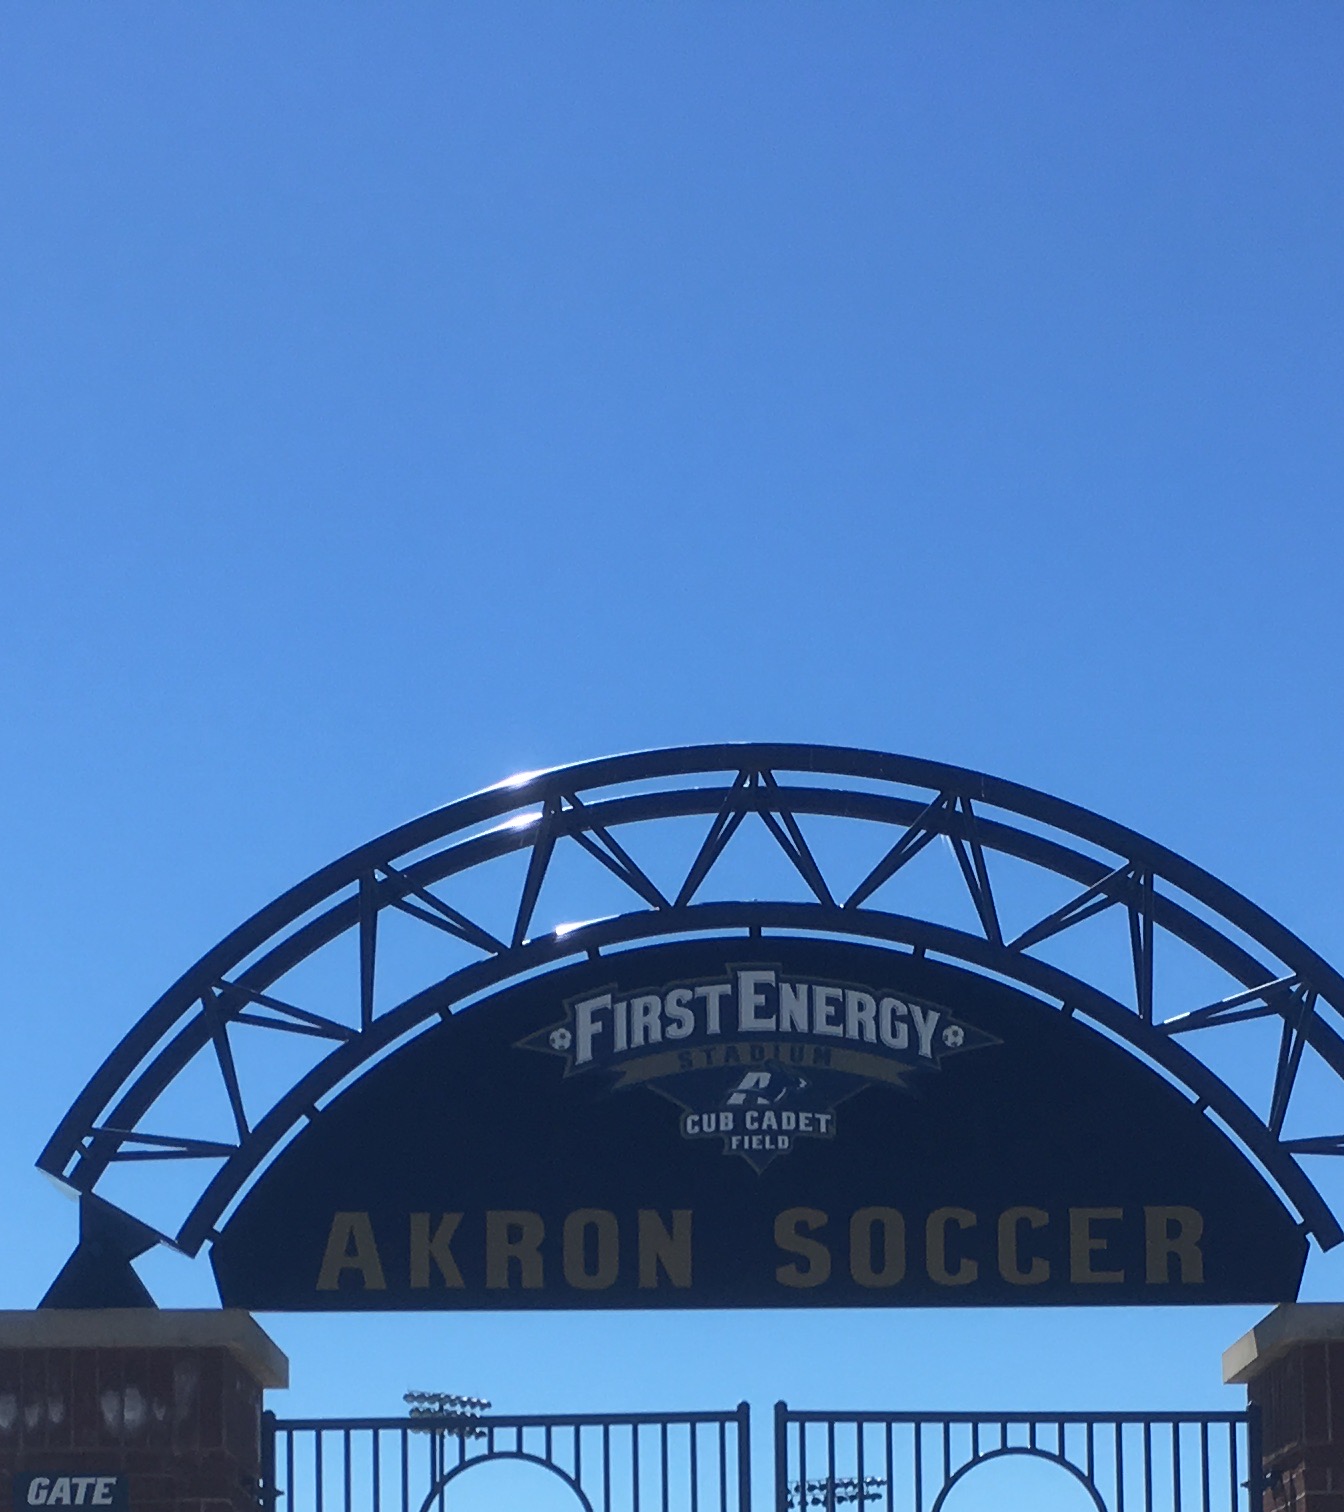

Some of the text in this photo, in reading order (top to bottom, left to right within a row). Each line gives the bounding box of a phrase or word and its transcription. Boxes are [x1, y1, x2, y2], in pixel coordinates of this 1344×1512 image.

[678, 1043, 834, 1069] STADIUM
[686, 1111, 832, 1135] CUB CADET
[731, 1134, 790, 1152] FIELD
[316, 1206, 1205, 1293] AKRON SOCCER
[27, 1477, 116, 1505] GATE
